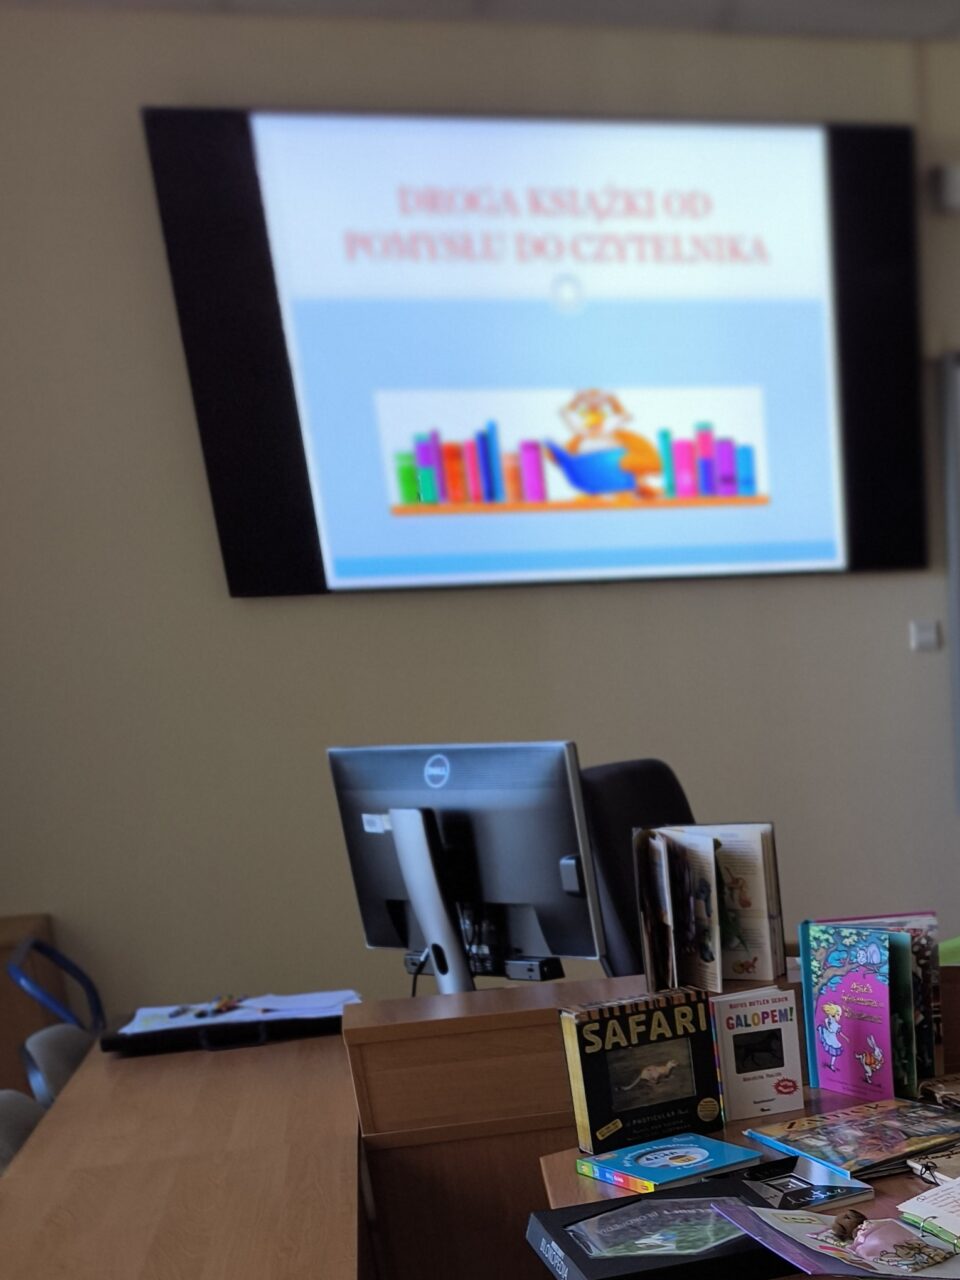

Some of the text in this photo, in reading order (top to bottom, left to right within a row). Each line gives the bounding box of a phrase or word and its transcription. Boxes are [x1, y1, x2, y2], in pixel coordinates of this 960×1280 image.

[396, 180, 714, 223] DROGA KSIĄŻKI OD
[343, 230, 770, 265] POMYSŁU DO CZYTELNIKA
[582, 1003, 707, 1054] SAFARI
[726, 1006, 795, 1031] GALOPEM!
